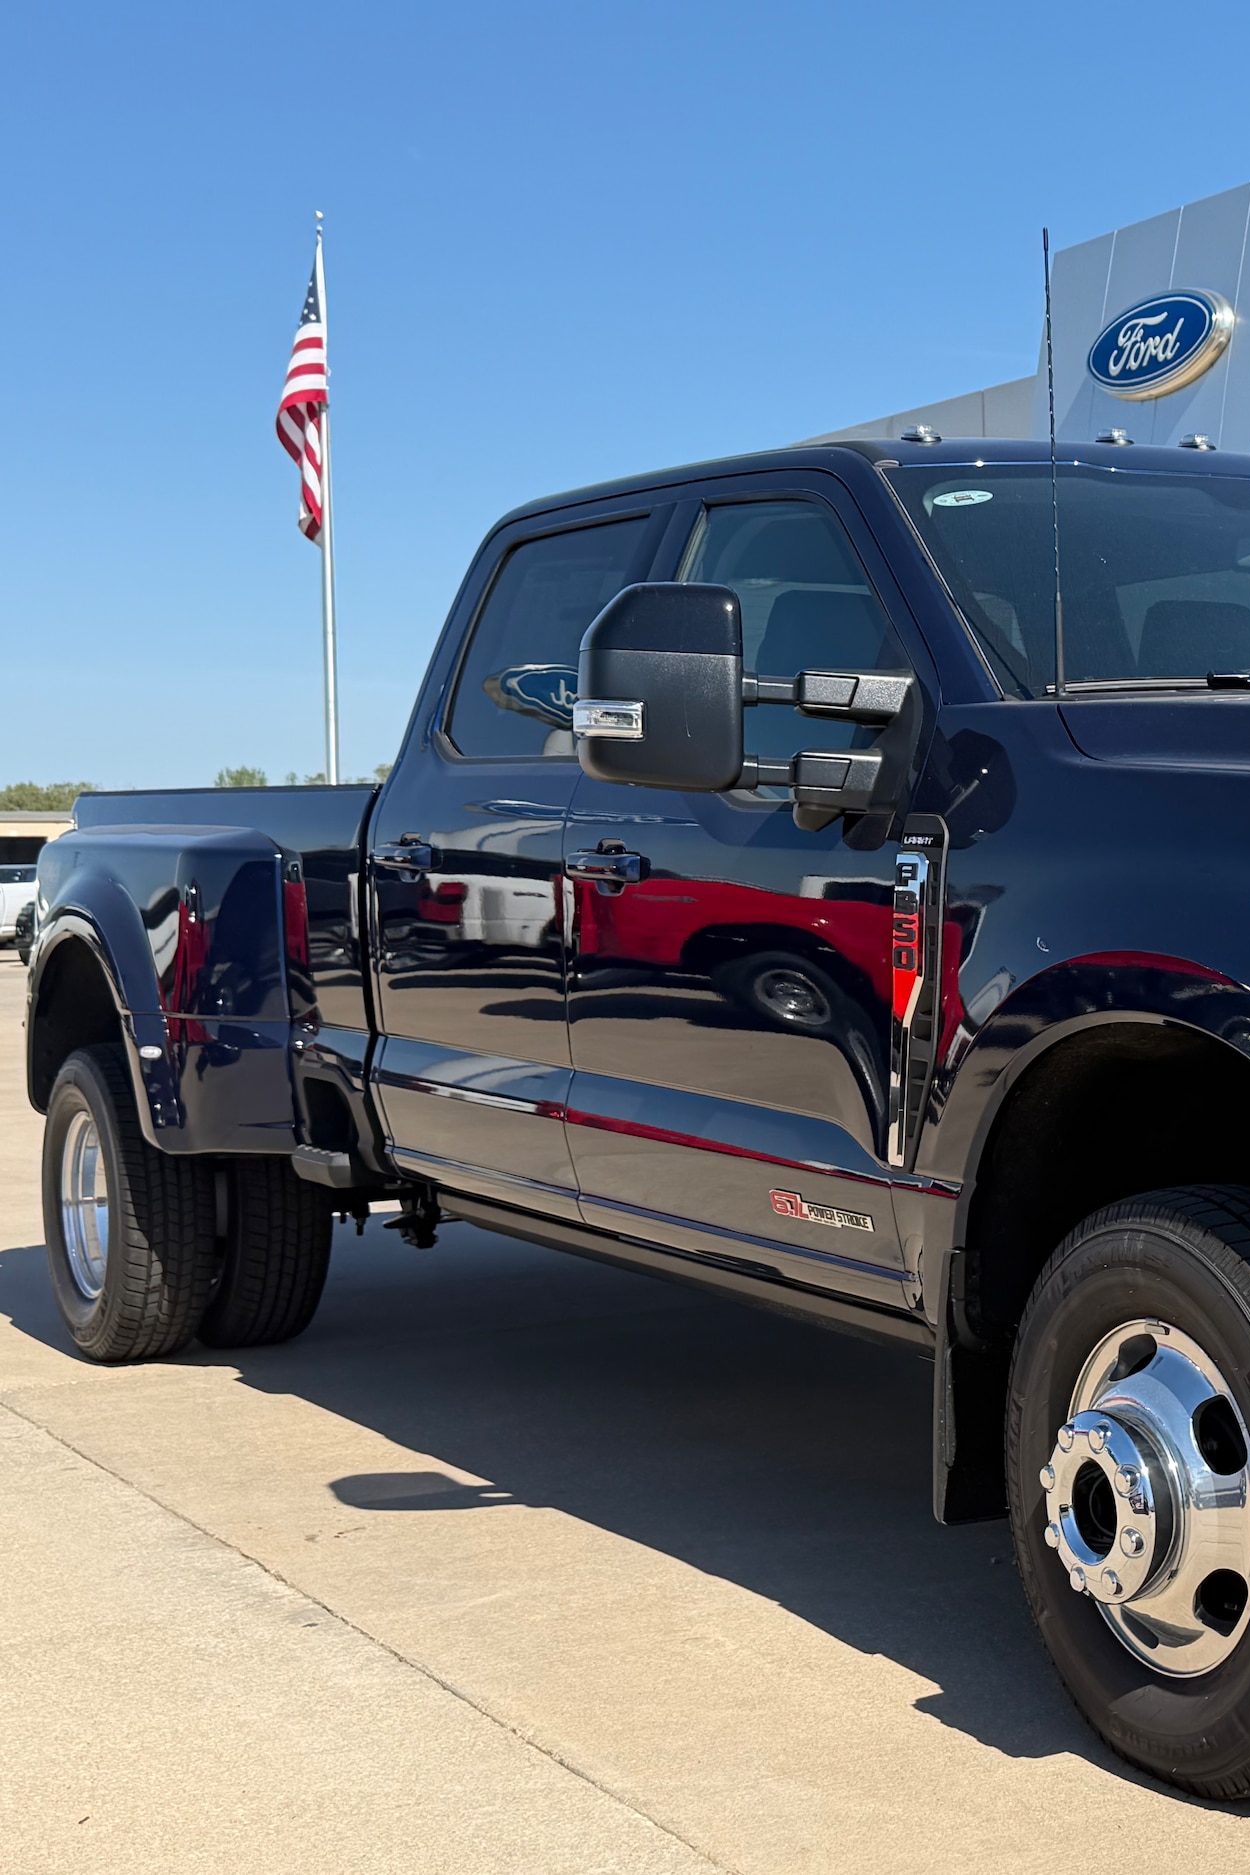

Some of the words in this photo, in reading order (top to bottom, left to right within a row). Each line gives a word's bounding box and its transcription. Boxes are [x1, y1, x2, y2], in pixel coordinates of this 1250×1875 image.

[1108, 311, 1185, 377] Ford
[808, 1205, 836, 1222] POWER
[836, 1211, 870, 1229] STROKE
